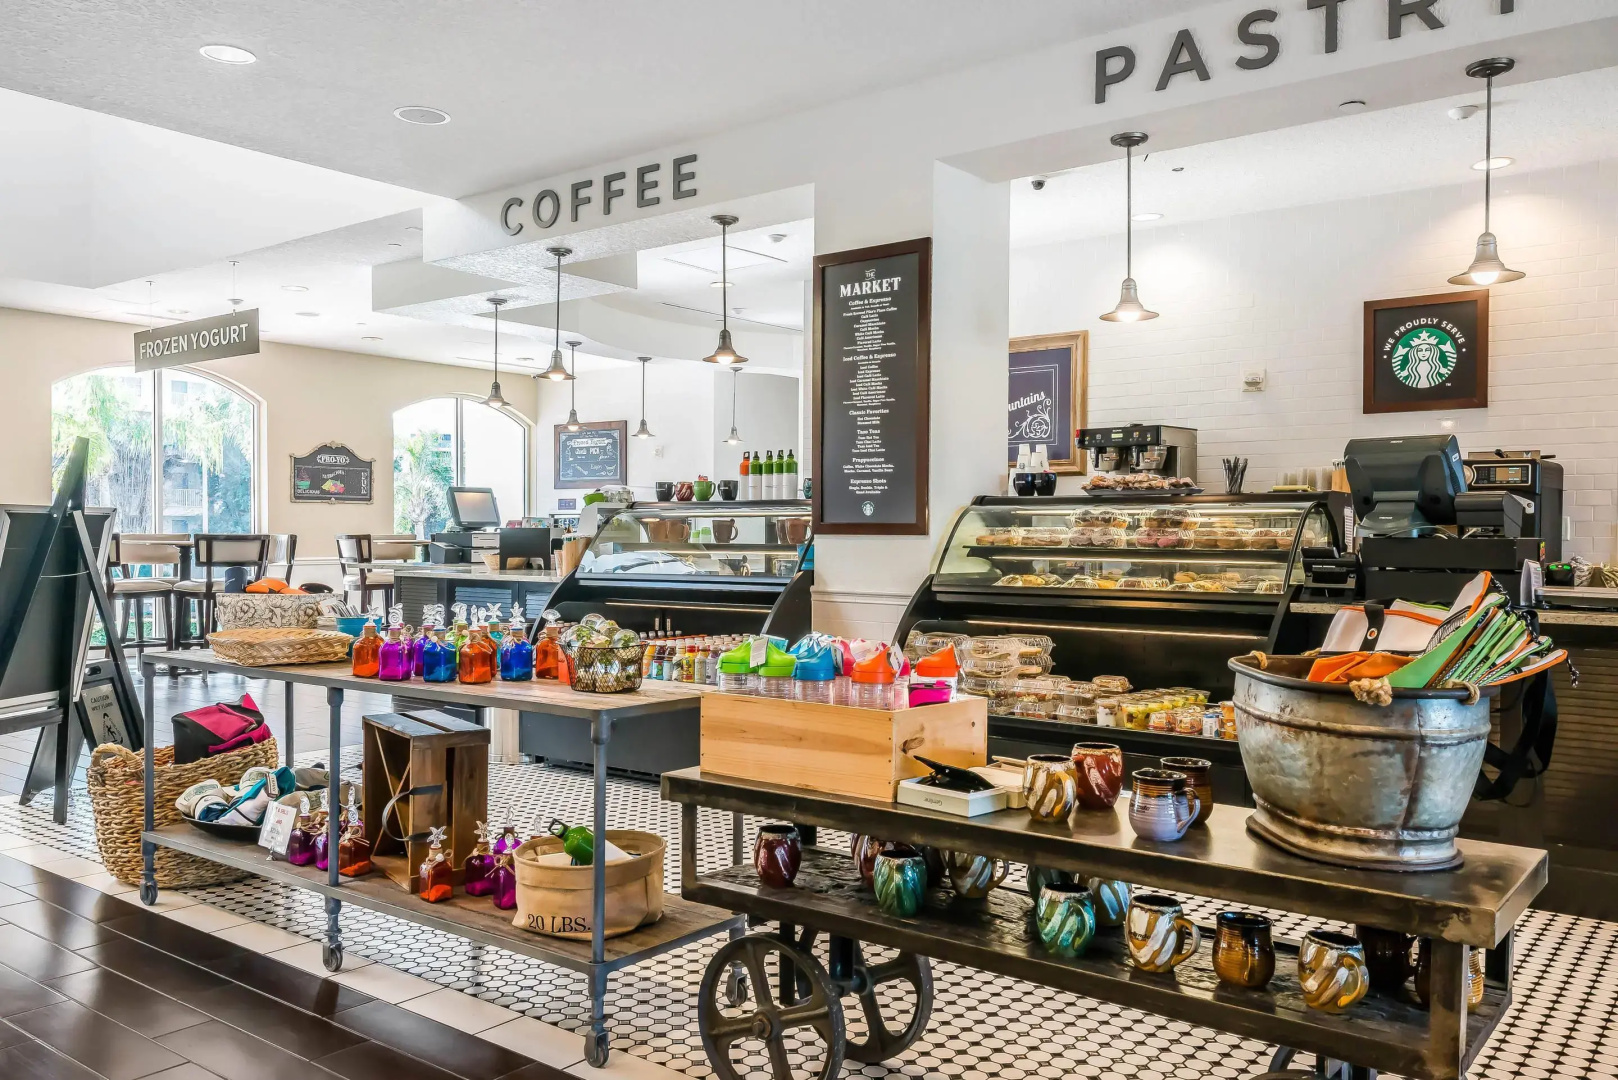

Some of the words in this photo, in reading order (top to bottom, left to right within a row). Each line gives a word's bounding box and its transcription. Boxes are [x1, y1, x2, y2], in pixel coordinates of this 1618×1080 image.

[1095, 0, 1514, 104] PASTR
[501, 154, 697, 236] COFFEE
[840, 277, 901, 298] MARKET
[140, 335, 187, 359] FROZEN
[191, 324, 248, 350] YOGURT
[1383, 338, 1395, 351] WE
[1394, 318, 1439, 337] PROUDLY
[1441, 321, 1465, 344] SERVE
[91, 694, 109, 703] CAUTION
[528, 914, 545, 930] 20
[551, 916, 591, 933] LBS.
